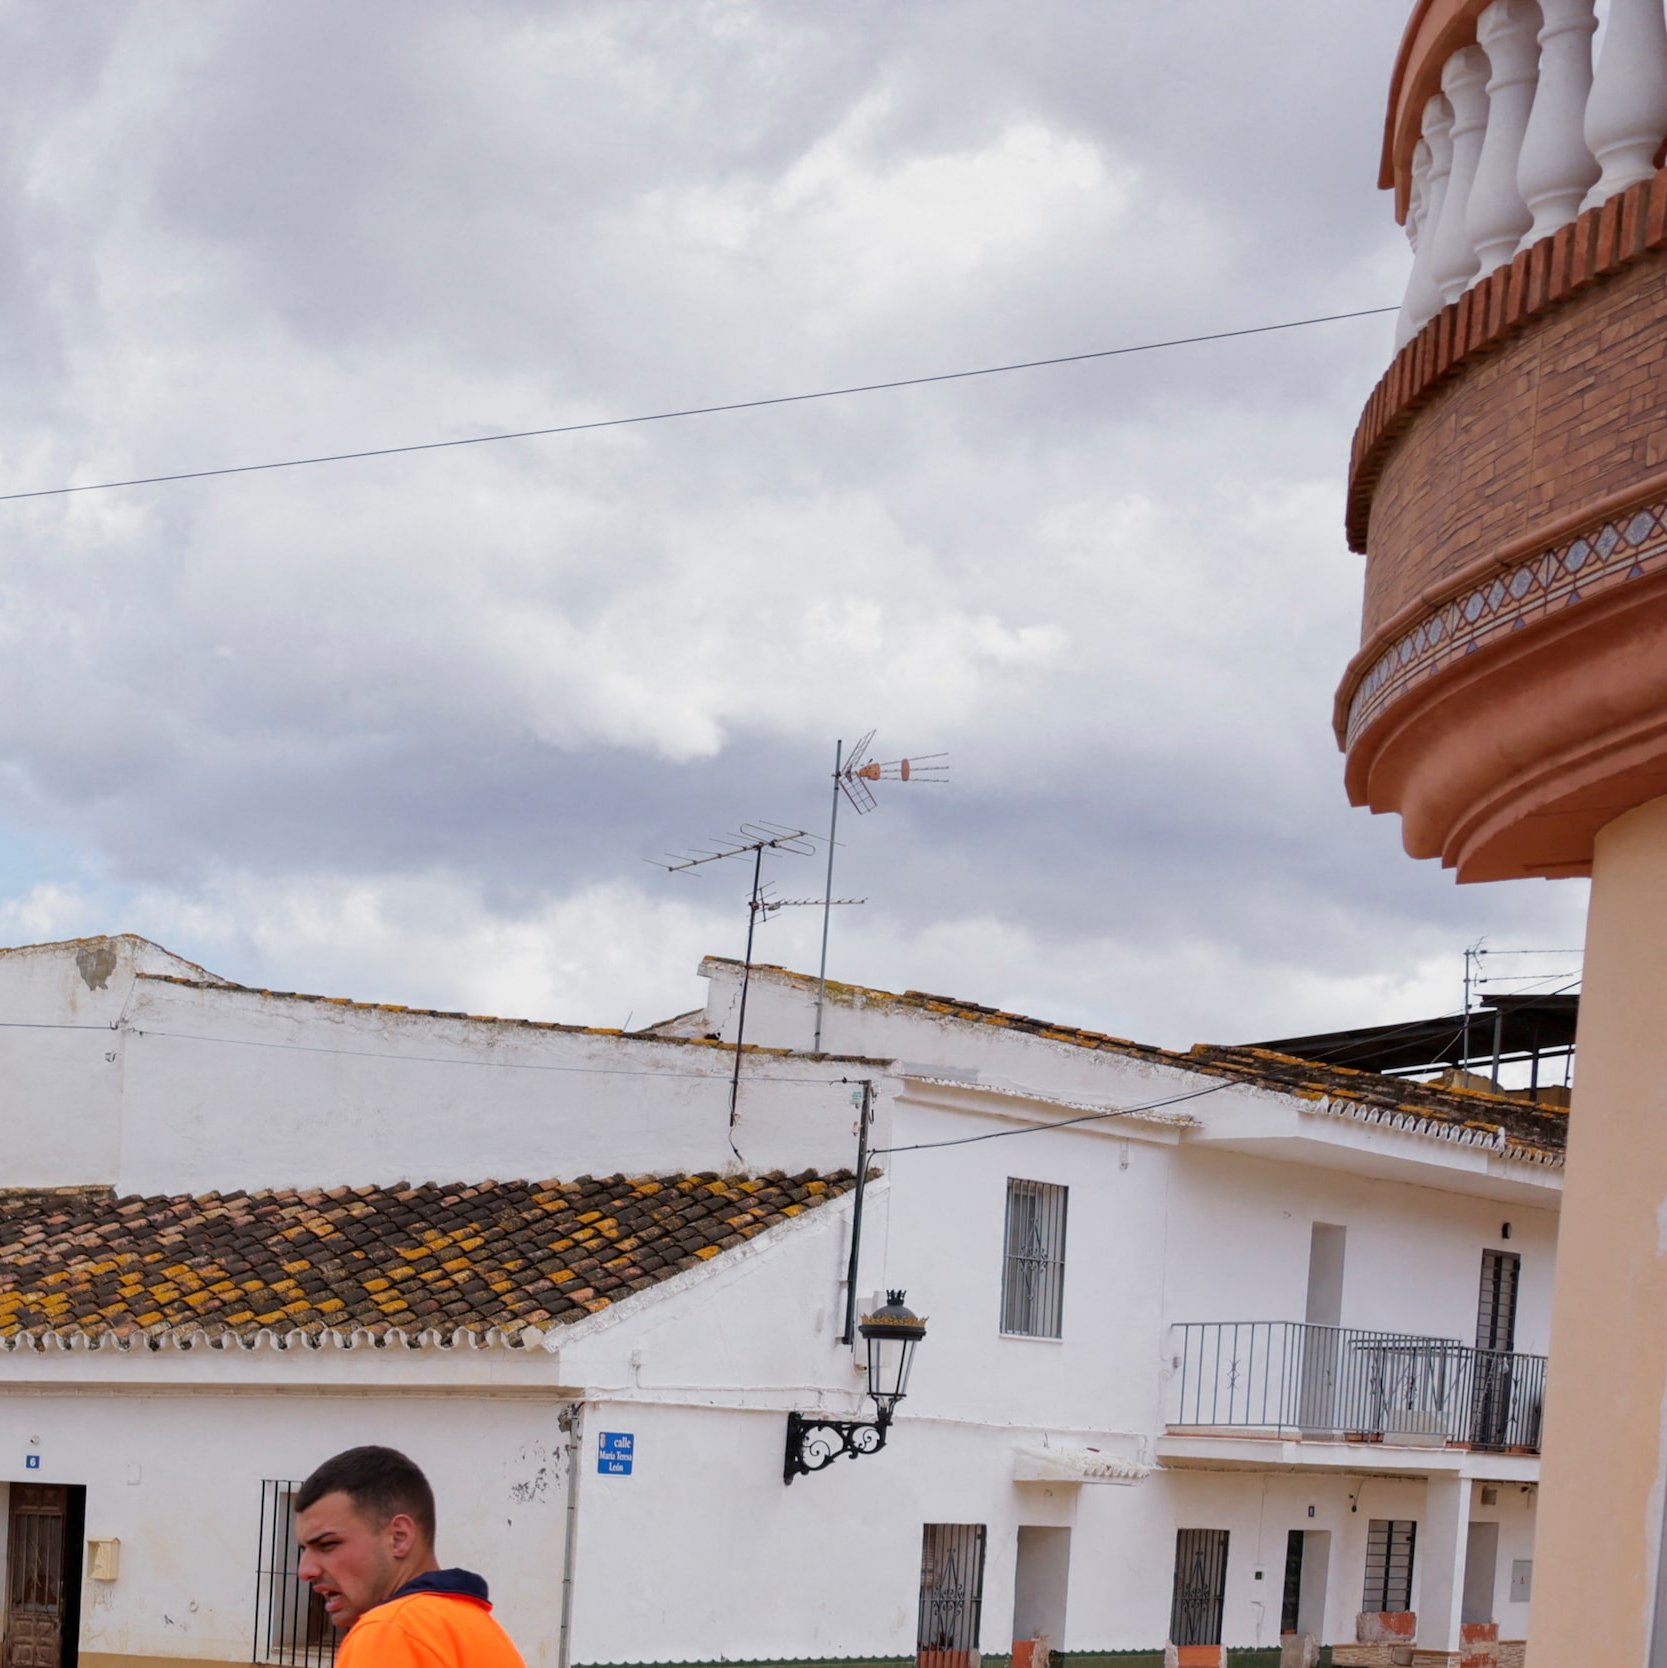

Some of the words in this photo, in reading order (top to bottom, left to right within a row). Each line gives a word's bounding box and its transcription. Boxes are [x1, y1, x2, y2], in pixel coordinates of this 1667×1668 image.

[614, 1436, 631, 1449] calle
[599, 1450, 615, 1460] María
[616, 1451, 632, 1461] Teresa
[29, 1457, 37, 1467] 6
[609, 1461, 624, 1472] León
